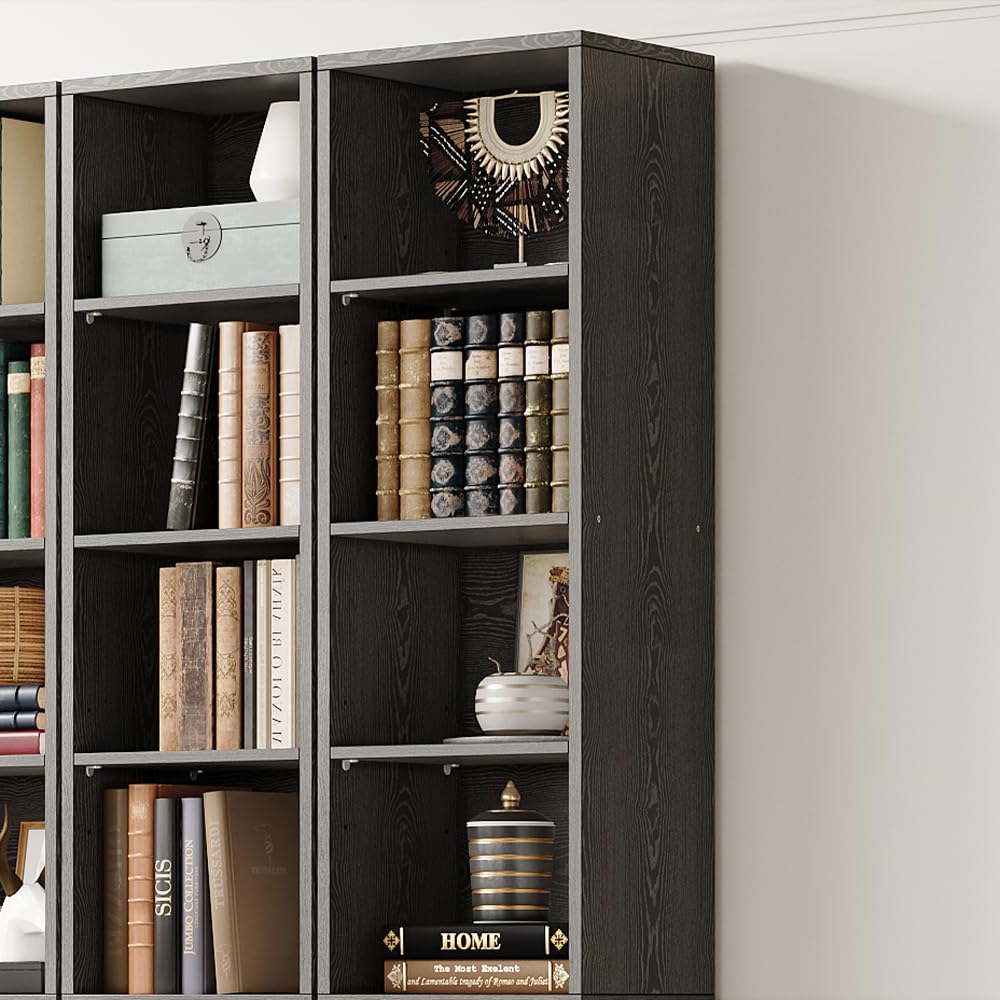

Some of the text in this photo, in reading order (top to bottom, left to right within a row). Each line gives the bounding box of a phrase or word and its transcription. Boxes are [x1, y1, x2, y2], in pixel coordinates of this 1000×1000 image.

[155, 858, 172, 917] SICIS
[208, 820, 227, 910] TRUSSARDI
[183, 839, 197, 956] JUMBO COLLECTION
[433, 964, 451, 973] The
[454, 964, 477, 973] Most
[440, 932, 501, 951] HOME
